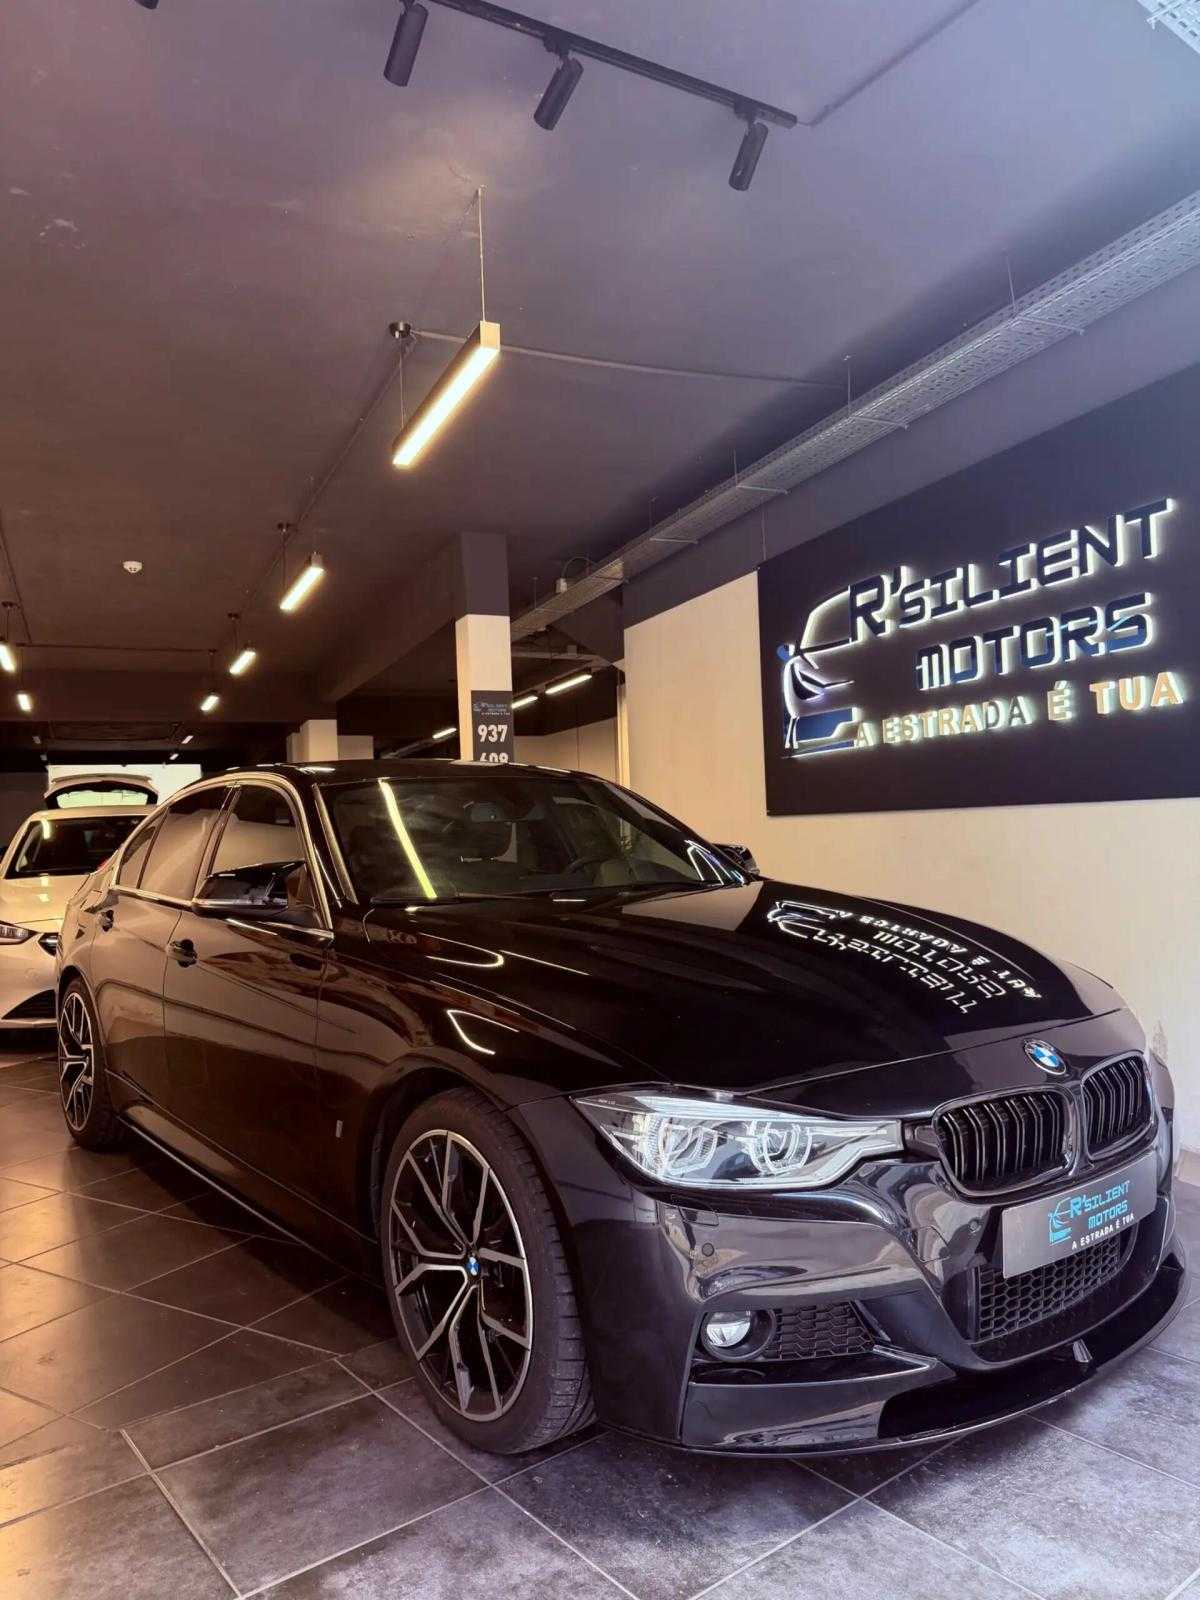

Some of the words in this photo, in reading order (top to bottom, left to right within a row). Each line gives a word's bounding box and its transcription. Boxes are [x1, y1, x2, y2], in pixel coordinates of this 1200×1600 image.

[848, 499, 1174, 643] R'SILIENT
[915, 592, 1152, 691] MOTORS
[854, 721, 875, 748] A
[882, 695, 1034, 744] ESTRADA
[1047, 680, 1073, 721] É
[1089, 671, 1185, 714] TUA
[478, 724, 508, 743] 937
[1070, 1180, 1131, 1218] R'SILIENT
[1088, 1200, 1128, 1230] MOTORS
[1071, 1240, 1078, 1250] A
[1080, 1224, 1114, 1247] ESTRADA
[1122, 1212, 1135, 1225] TUA
